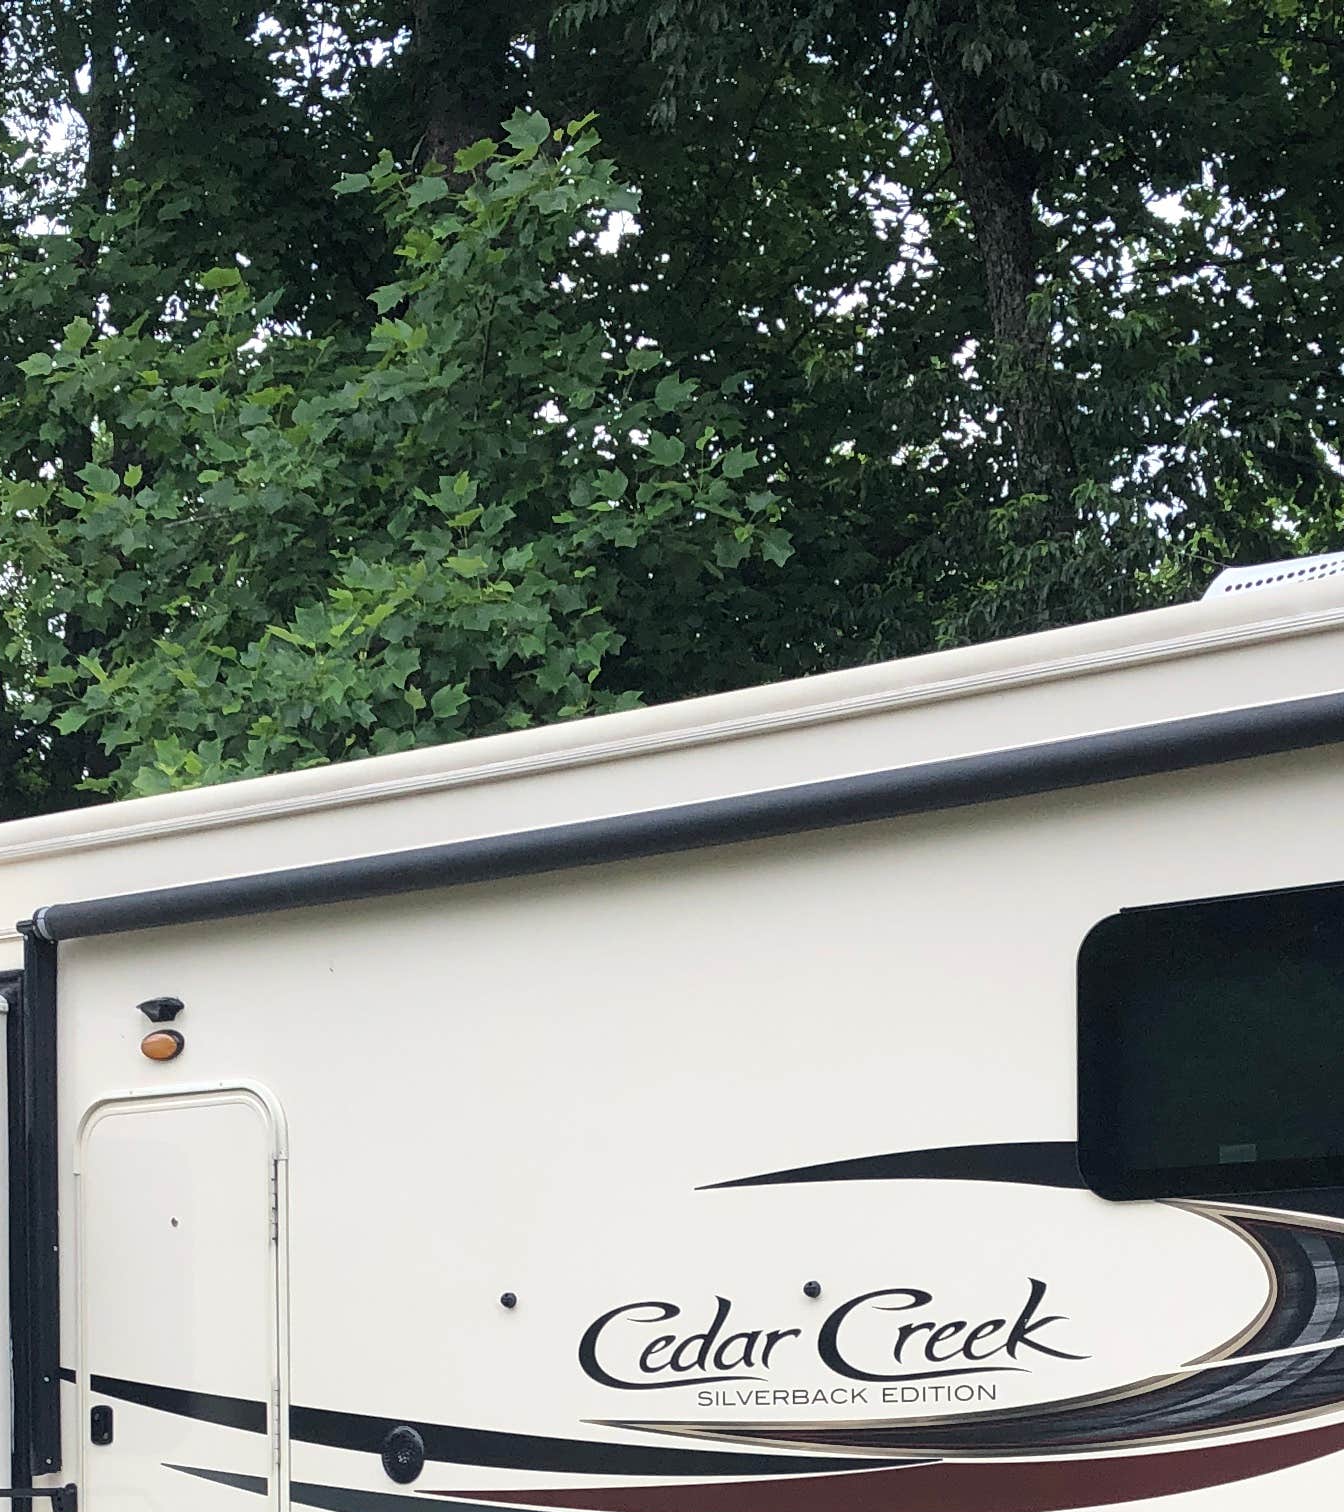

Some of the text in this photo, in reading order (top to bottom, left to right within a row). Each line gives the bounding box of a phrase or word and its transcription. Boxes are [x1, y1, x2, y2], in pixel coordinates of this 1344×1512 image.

[578, 1277, 1093, 1391] Cedar Creek
[697, 1384, 997, 1408] SILVERBACK EDITION
